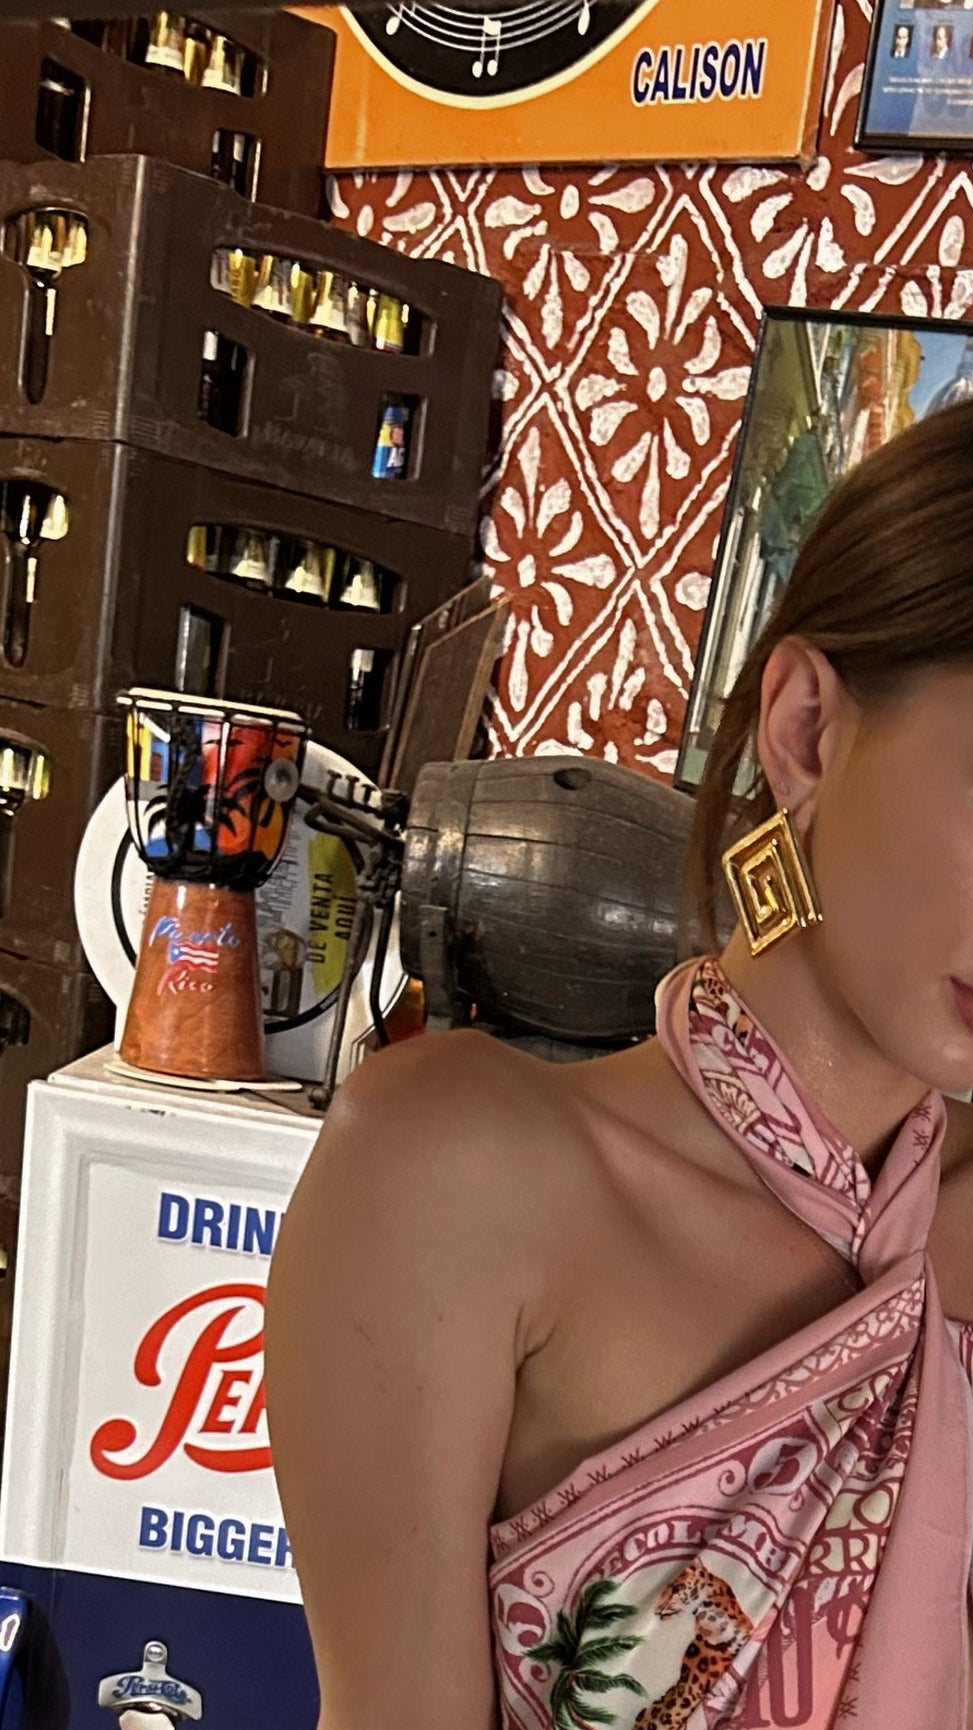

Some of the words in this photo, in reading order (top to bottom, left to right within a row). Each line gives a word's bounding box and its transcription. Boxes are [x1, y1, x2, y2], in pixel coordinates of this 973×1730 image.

[630, 40, 765, 105] CALISON
[309, 872, 334, 933] VENTA
[309, 941, 327, 964] DE
[158, 1192, 285, 1257] DRIN
